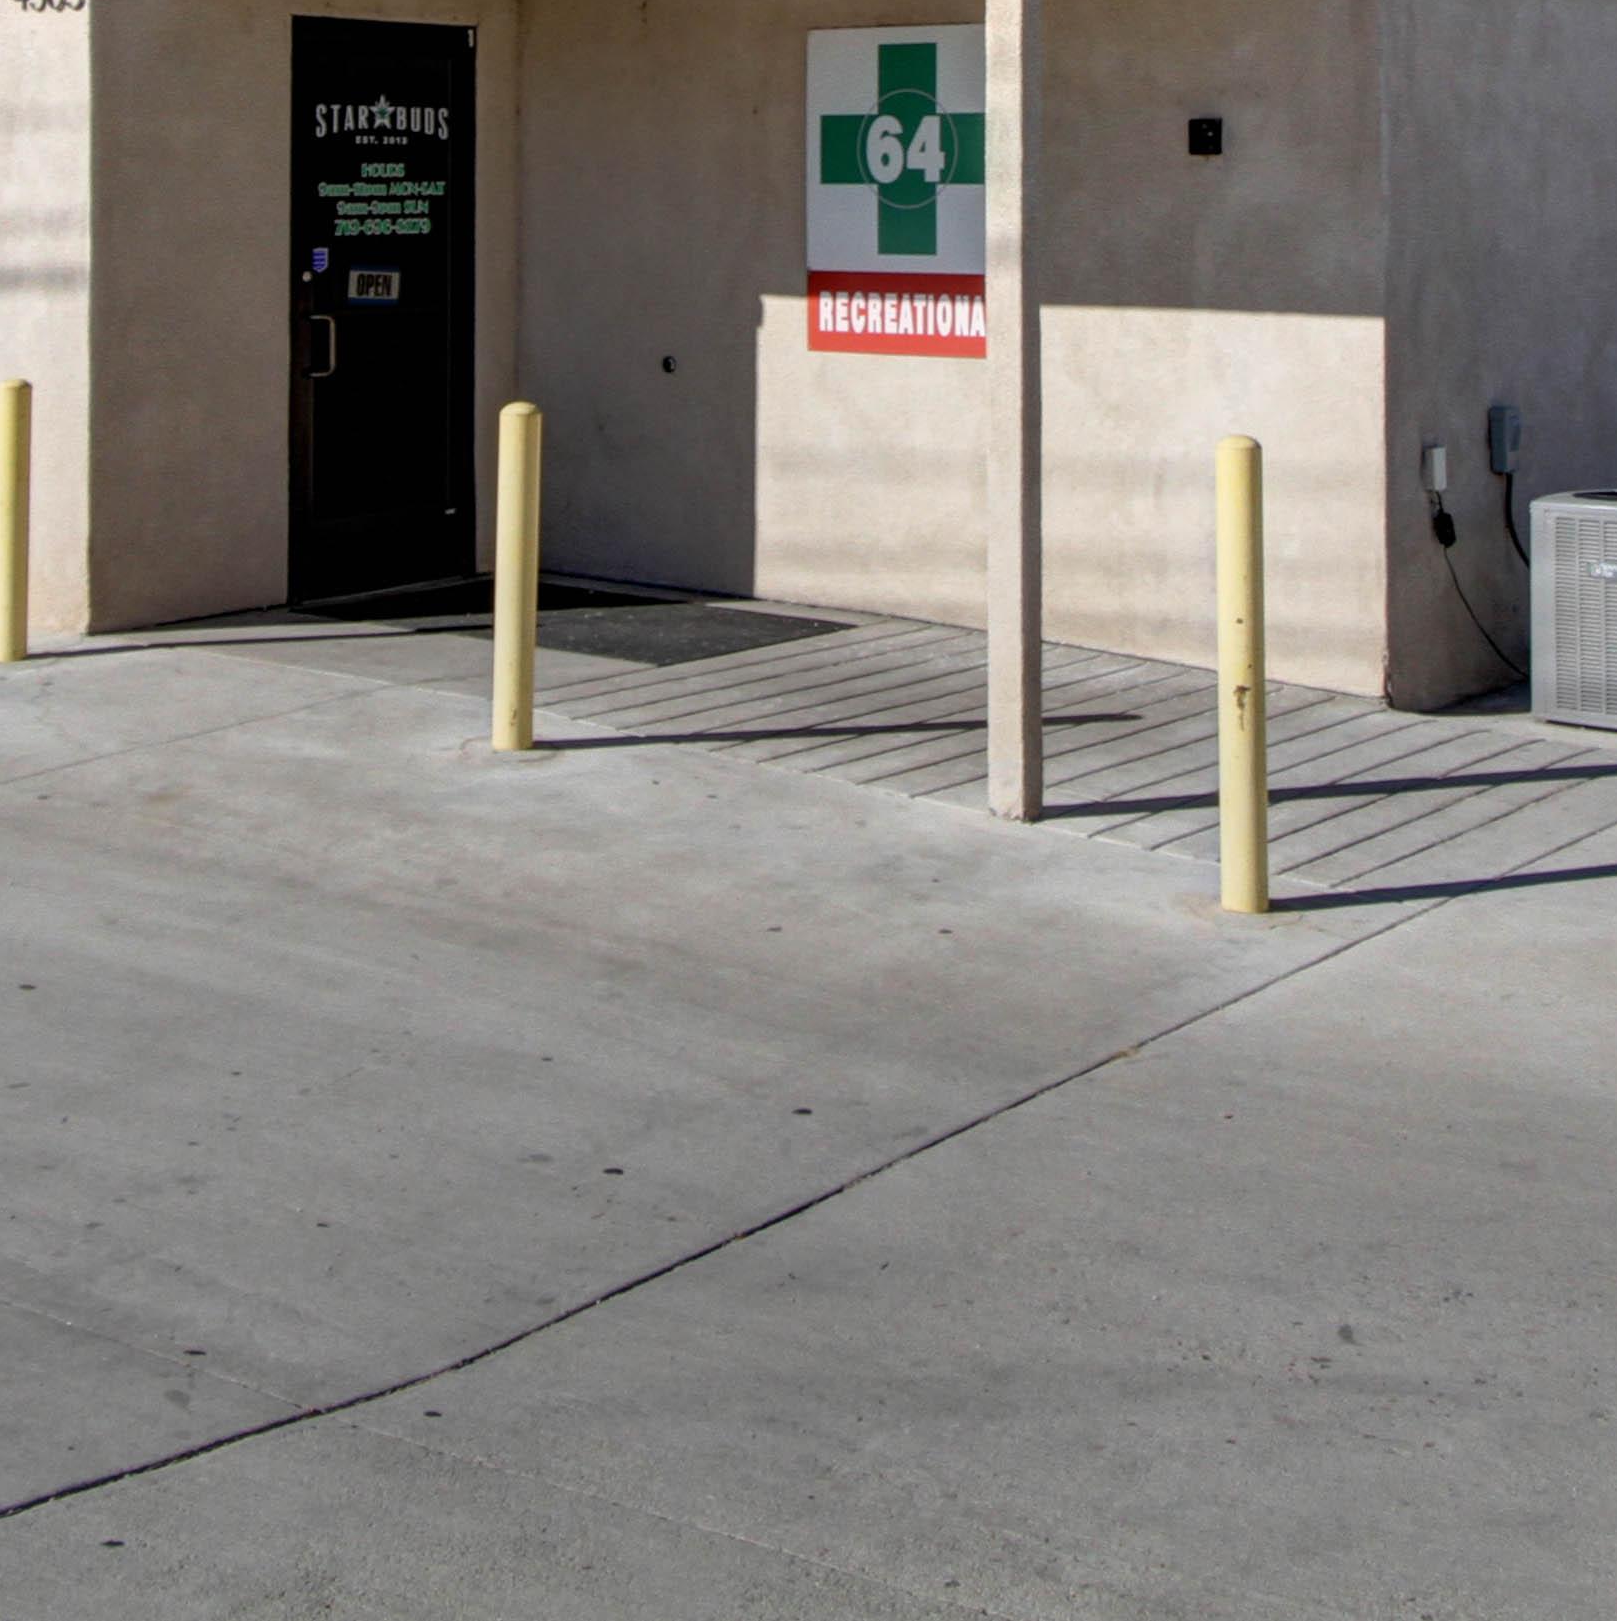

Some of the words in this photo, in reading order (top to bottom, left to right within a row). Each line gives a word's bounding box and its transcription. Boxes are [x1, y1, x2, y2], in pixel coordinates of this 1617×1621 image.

[315, 103, 370, 138] STAR
[395, 106, 450, 140] BUDS
[866, 115, 945, 184] 64
[356, 273, 393, 296] OPEN
